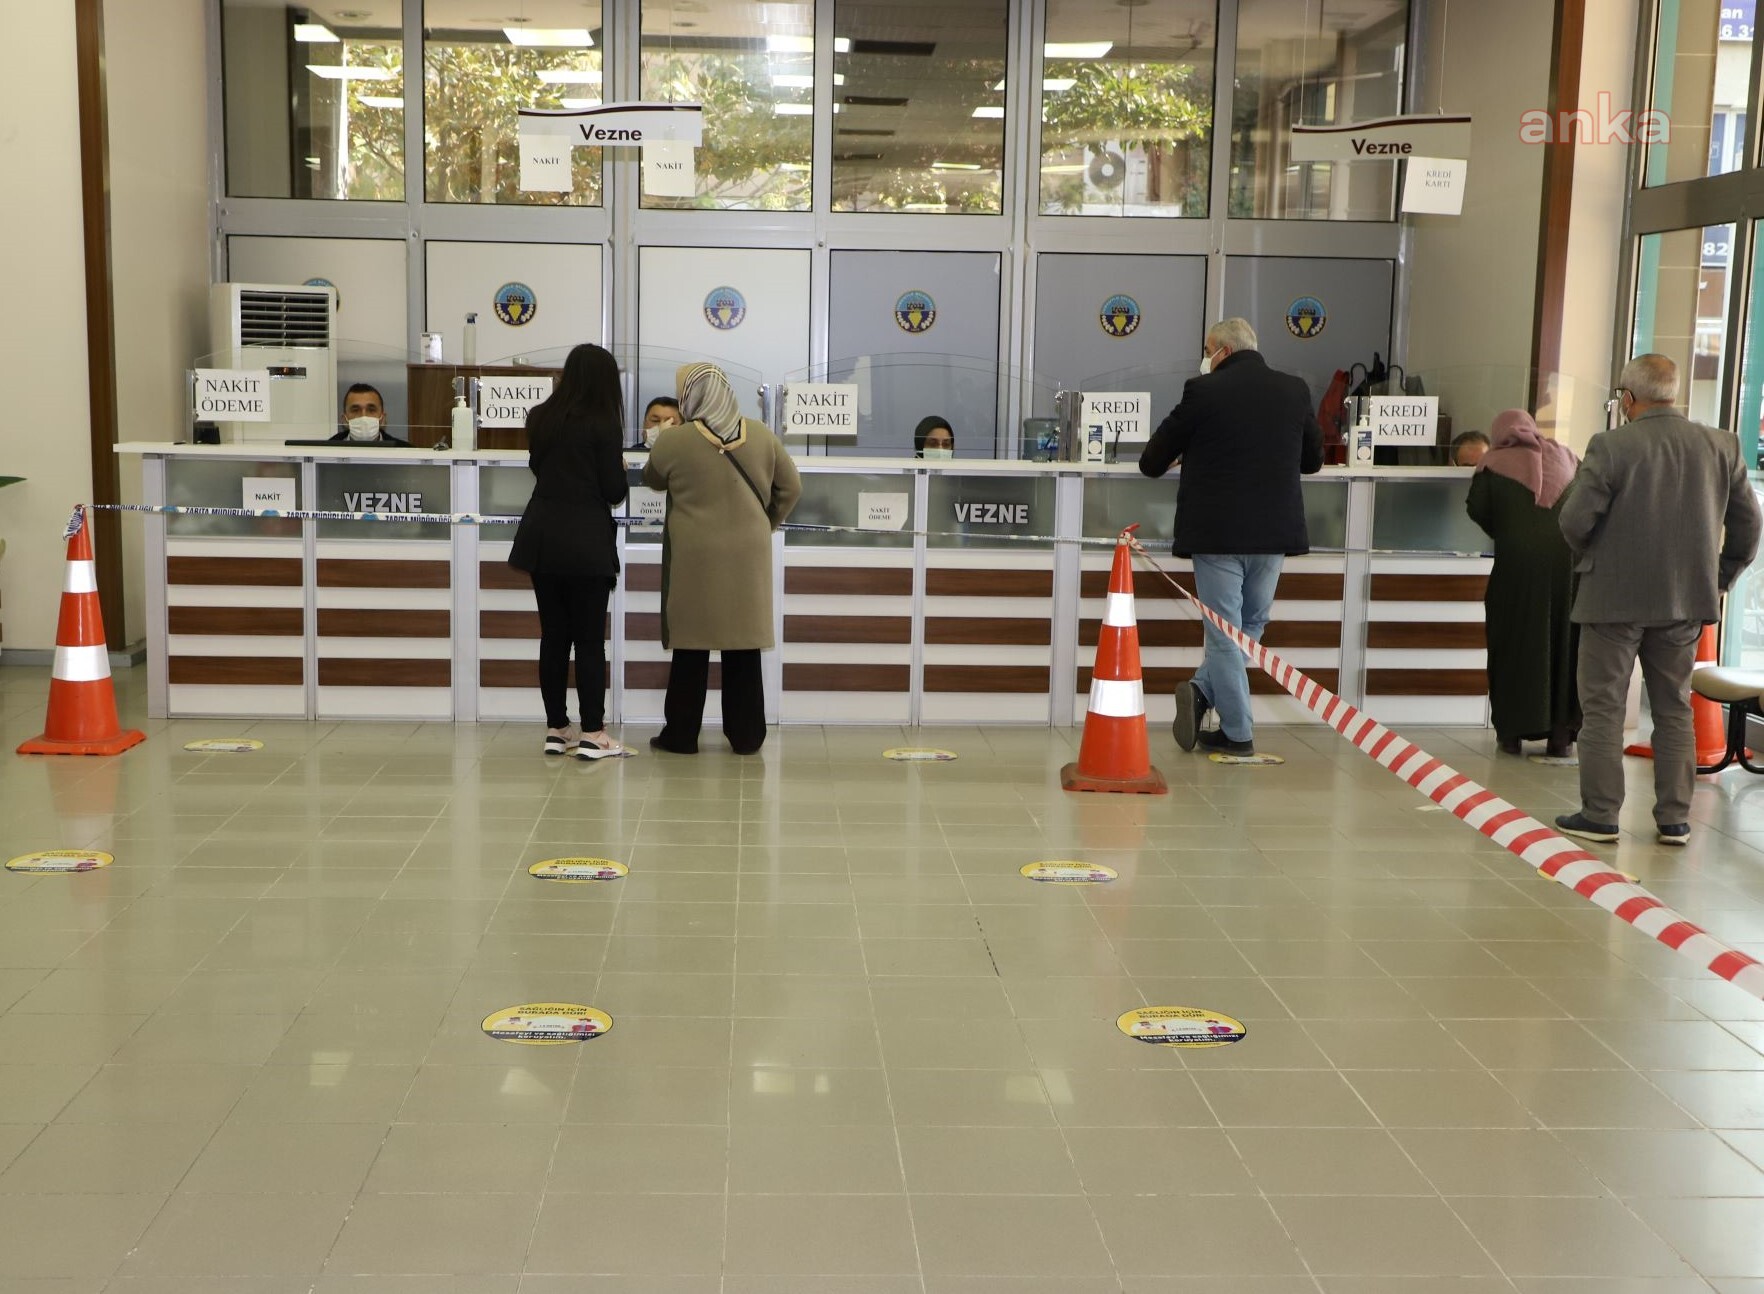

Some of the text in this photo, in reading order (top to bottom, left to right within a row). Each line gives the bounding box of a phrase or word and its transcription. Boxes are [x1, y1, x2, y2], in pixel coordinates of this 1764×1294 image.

[579, 123, 643, 141] Vezne
[1351, 138, 1413, 155] Vezne
[532, 155, 561, 165] NAKİT
[656, 160, 683, 170] NAKİT
[1426, 169, 1452, 179] KREDİ
[1425, 179, 1451, 189] KARTI
[206, 377, 261, 393] NAKİT
[491, 384, 544, 400] NAKİT
[201, 396, 264, 413] ÖDEME
[797, 391, 849, 406] NAKİT
[1090, 398, 1140, 414] KREDİ
[1379, 402, 1428, 417] KREDİ
[792, 410, 852, 426] ÖDEME
[1104, 420, 1139, 433] ARTI
[1378, 423, 1427, 436] KARTI
[255, 491, 281, 501] NAKİT
[343, 492, 423, 513] VEZNE
[955, 503, 1029, 524] VEZNE
